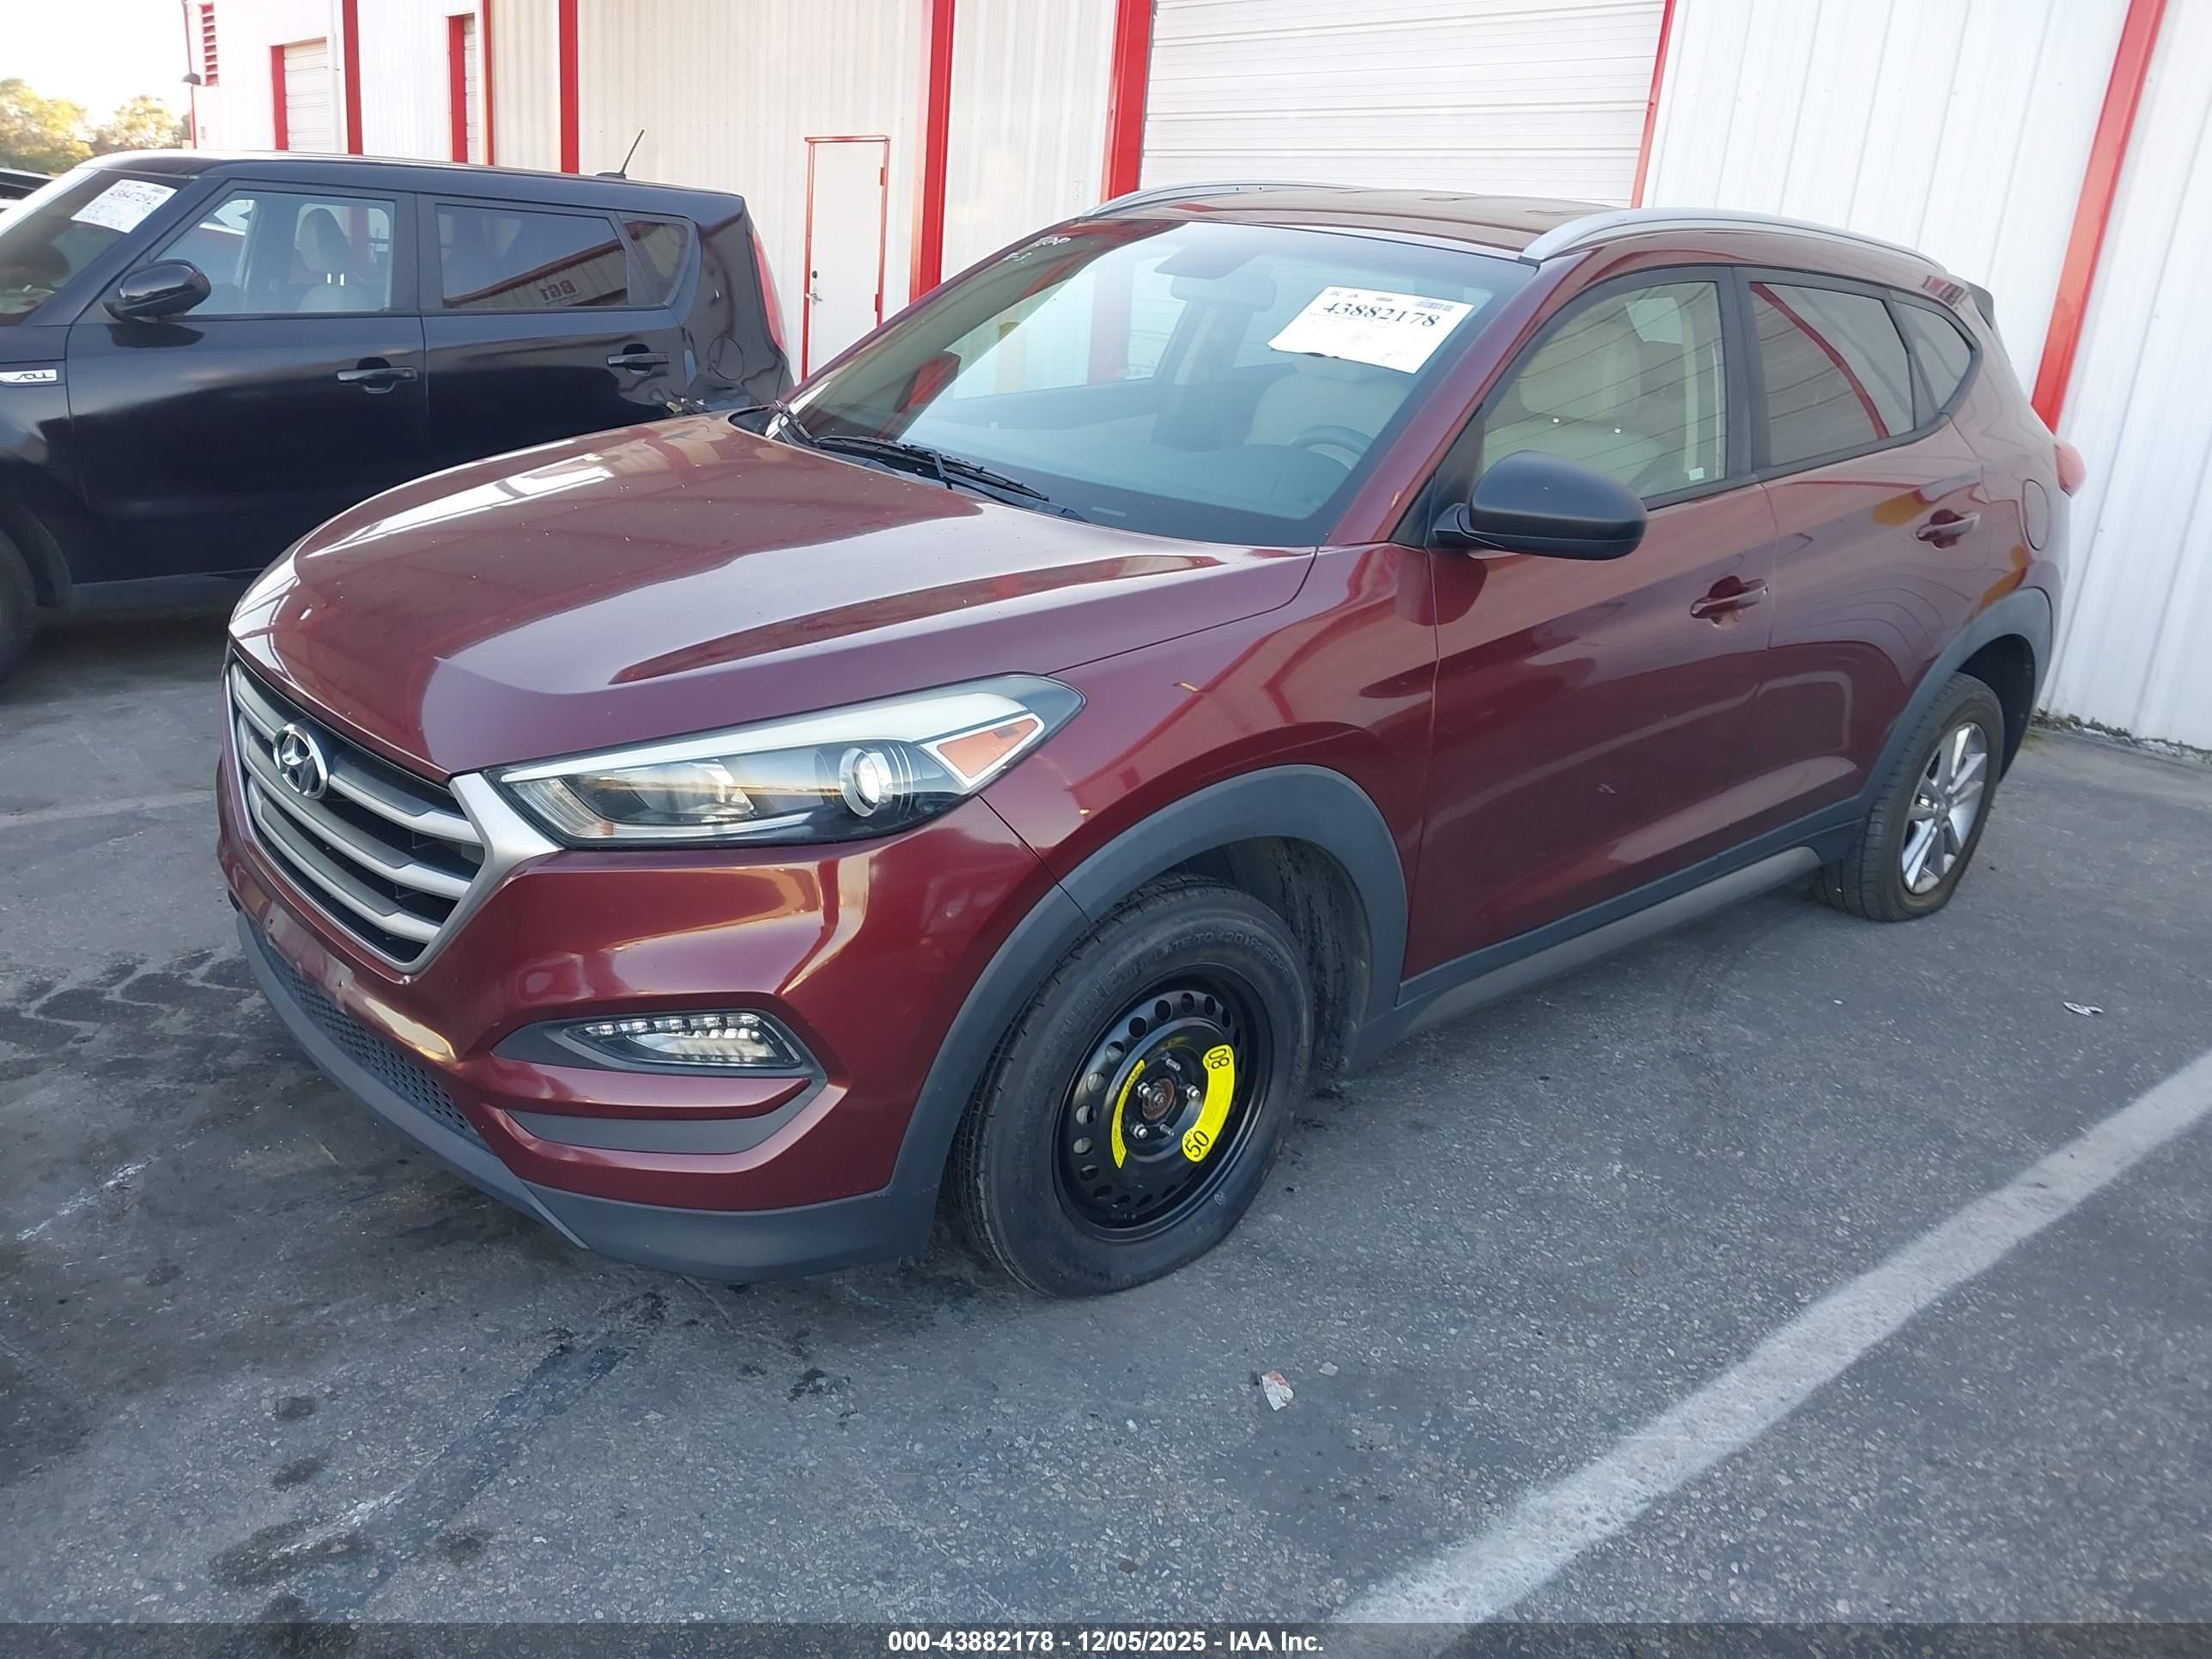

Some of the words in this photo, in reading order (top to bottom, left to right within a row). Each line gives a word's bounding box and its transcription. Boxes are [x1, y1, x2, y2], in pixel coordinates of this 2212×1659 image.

[1322, 301, 1441, 327] 43882178
[1209, 1048, 1230, 1069] 80
[1185, 1130, 1209, 1158] 50
